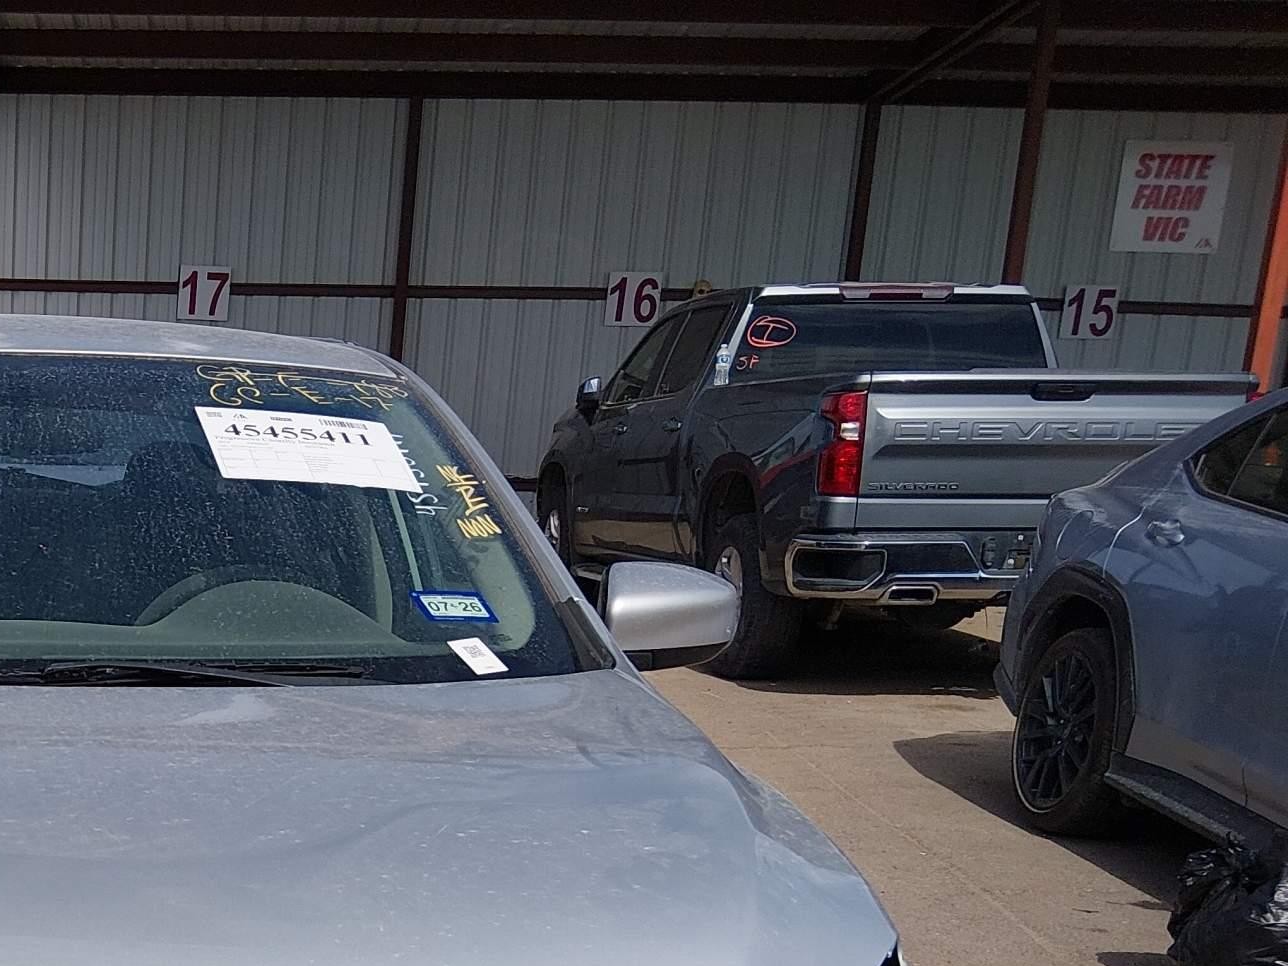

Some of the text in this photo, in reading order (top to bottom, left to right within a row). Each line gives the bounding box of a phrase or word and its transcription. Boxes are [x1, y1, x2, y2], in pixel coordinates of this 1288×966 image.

[1135, 153, 1216, 179] STATE
[1130, 184, 1208, 211] FARM
[1142, 216, 1191, 242] VIC
[182, 270, 230, 316] 17
[610, 276, 658, 323] 16
[1067, 288, 1117, 337] 15
[224, 423, 374, 447] 45455411
[894, 421, 1205, 441] CHEVROLE
[868, 482, 960, 491] SILVERADO
